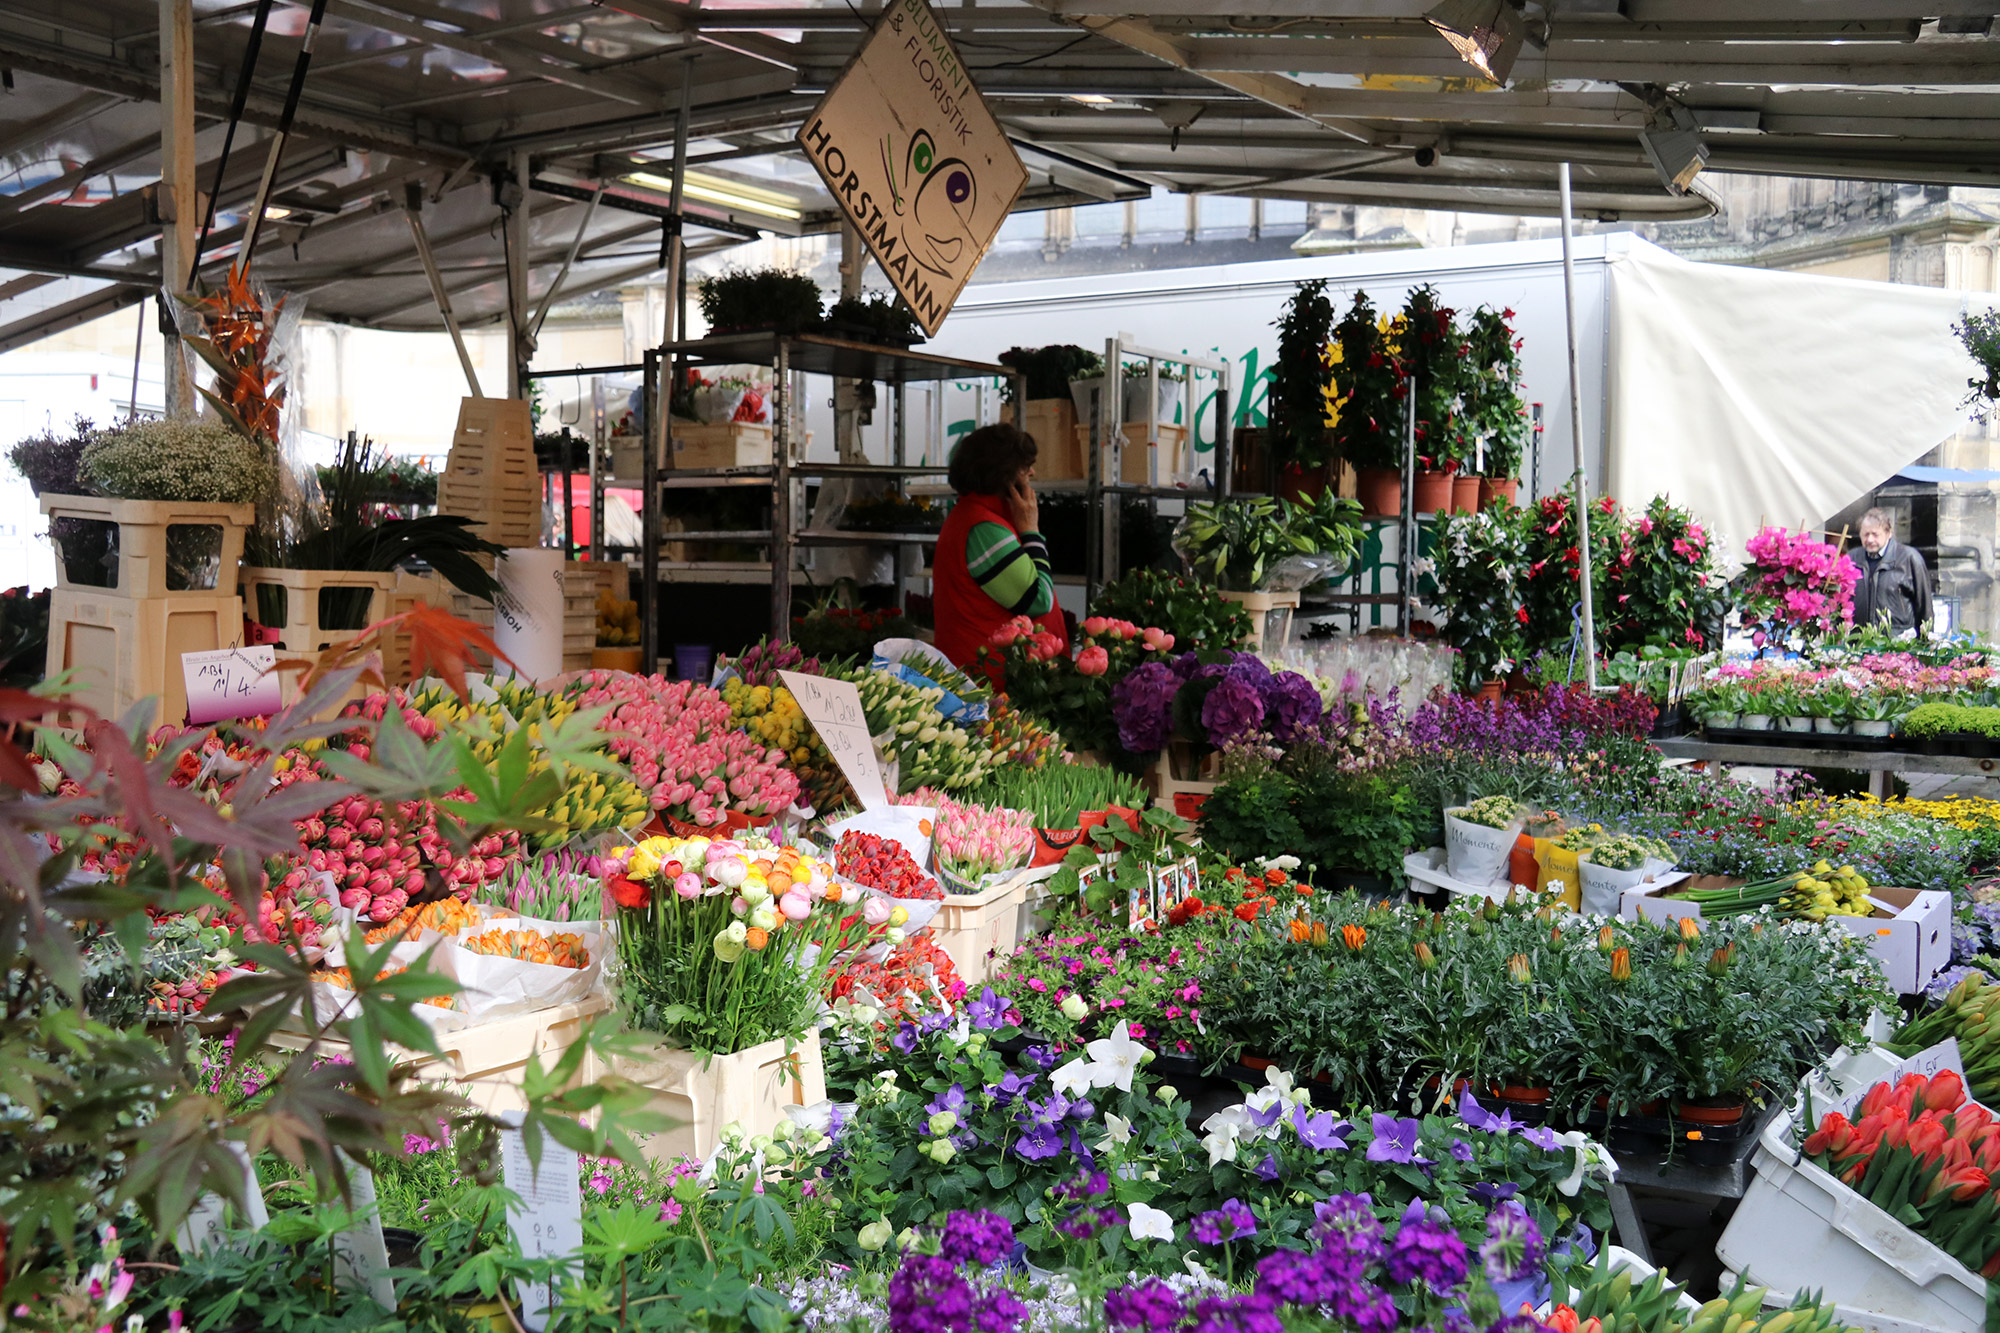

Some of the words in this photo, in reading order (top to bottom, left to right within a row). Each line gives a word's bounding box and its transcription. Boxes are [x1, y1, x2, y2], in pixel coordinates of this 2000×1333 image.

[904, 35, 973, 147] FLORISTIK
[806, 119, 944, 327] HORSTMANN
[1451, 826, 1502, 852] Moments
